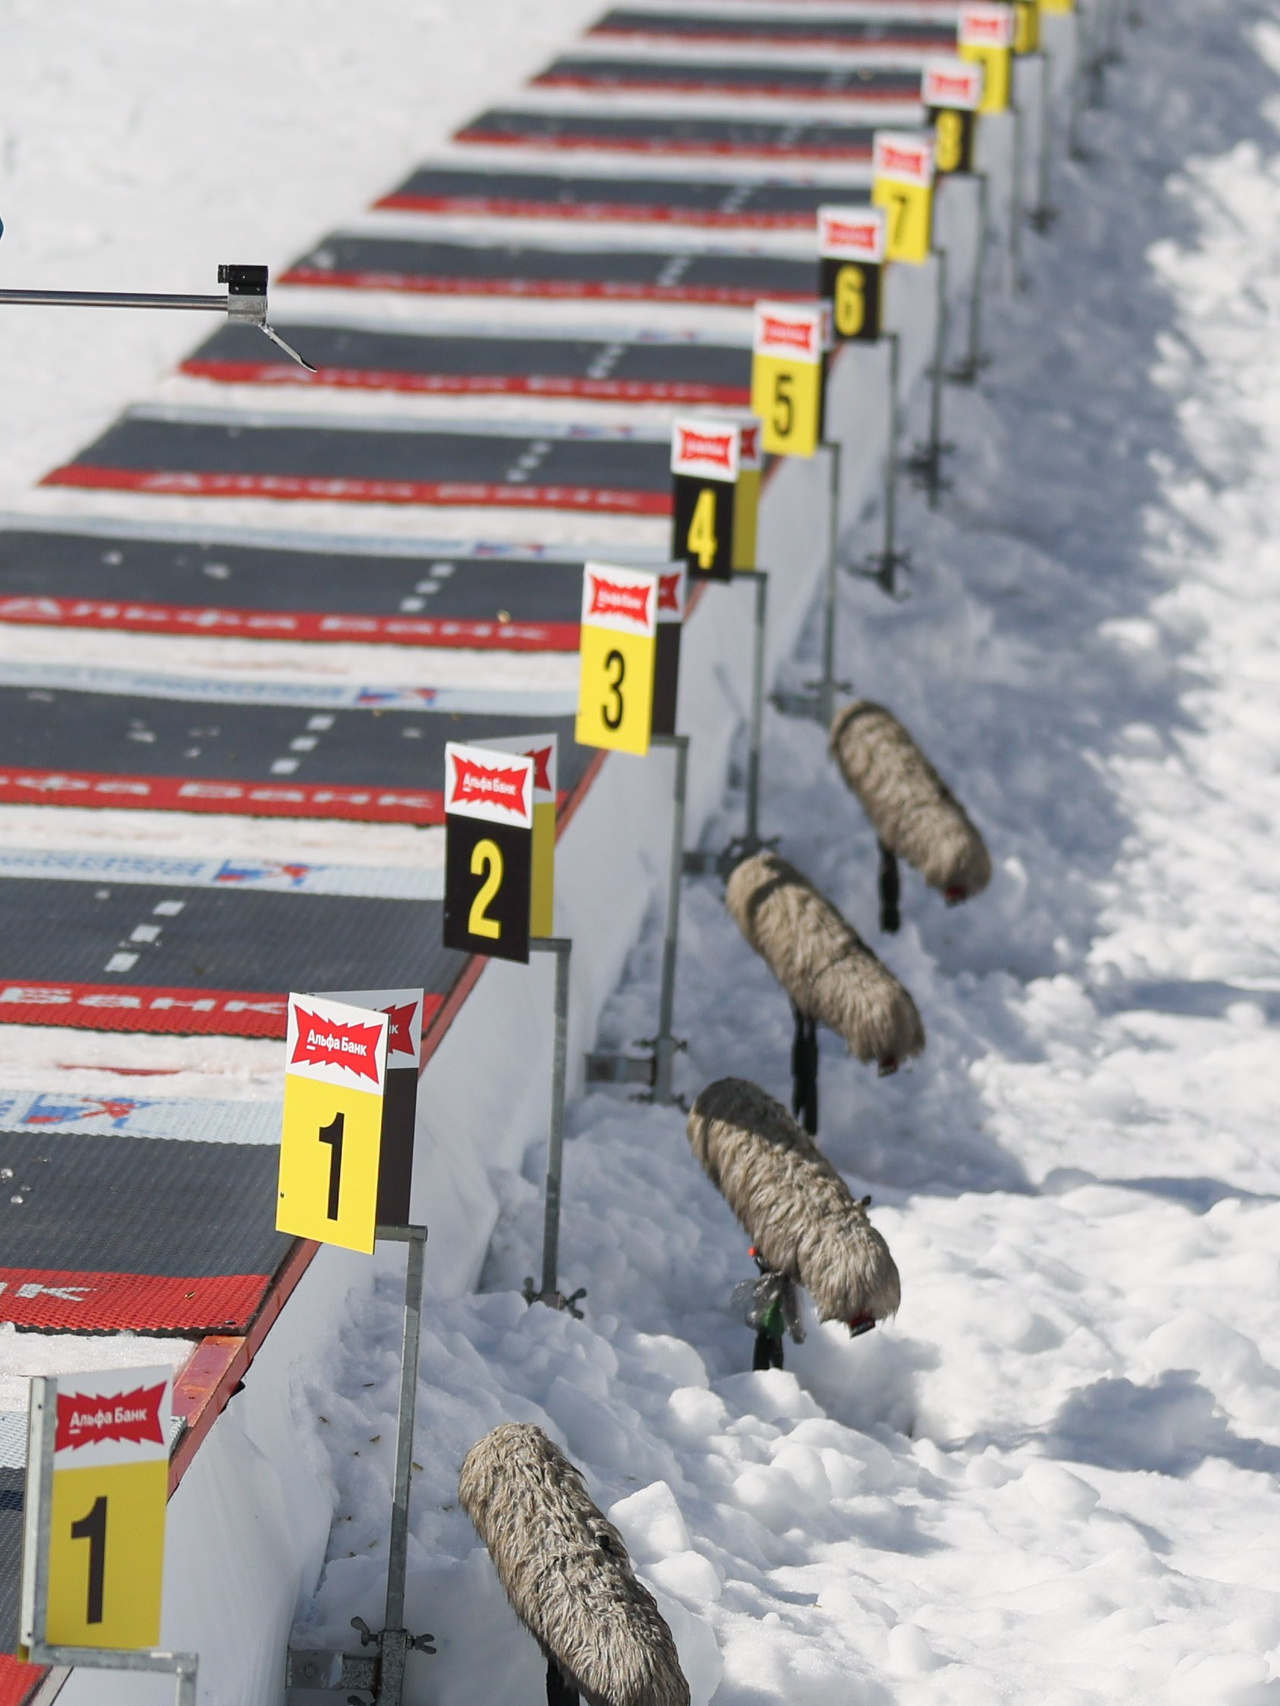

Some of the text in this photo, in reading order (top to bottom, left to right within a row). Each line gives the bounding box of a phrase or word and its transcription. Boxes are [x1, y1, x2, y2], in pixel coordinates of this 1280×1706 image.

[891, 193, 907, 247] 7
[835, 267, 865, 336] 6
[772, 372, 794, 438] 5
[687, 488, 718, 570] 4
[601, 649, 626, 729] 3
[463, 772, 517, 796] Альфа Банк
[468, 838, 504, 940] 2
[307, 1029, 367, 1056] Альфа Банк
[319, 1112, 345, 1221] 1
[70, 1406, 147, 1432] Альфа Банк
[71, 1496, 108, 1624] 1
